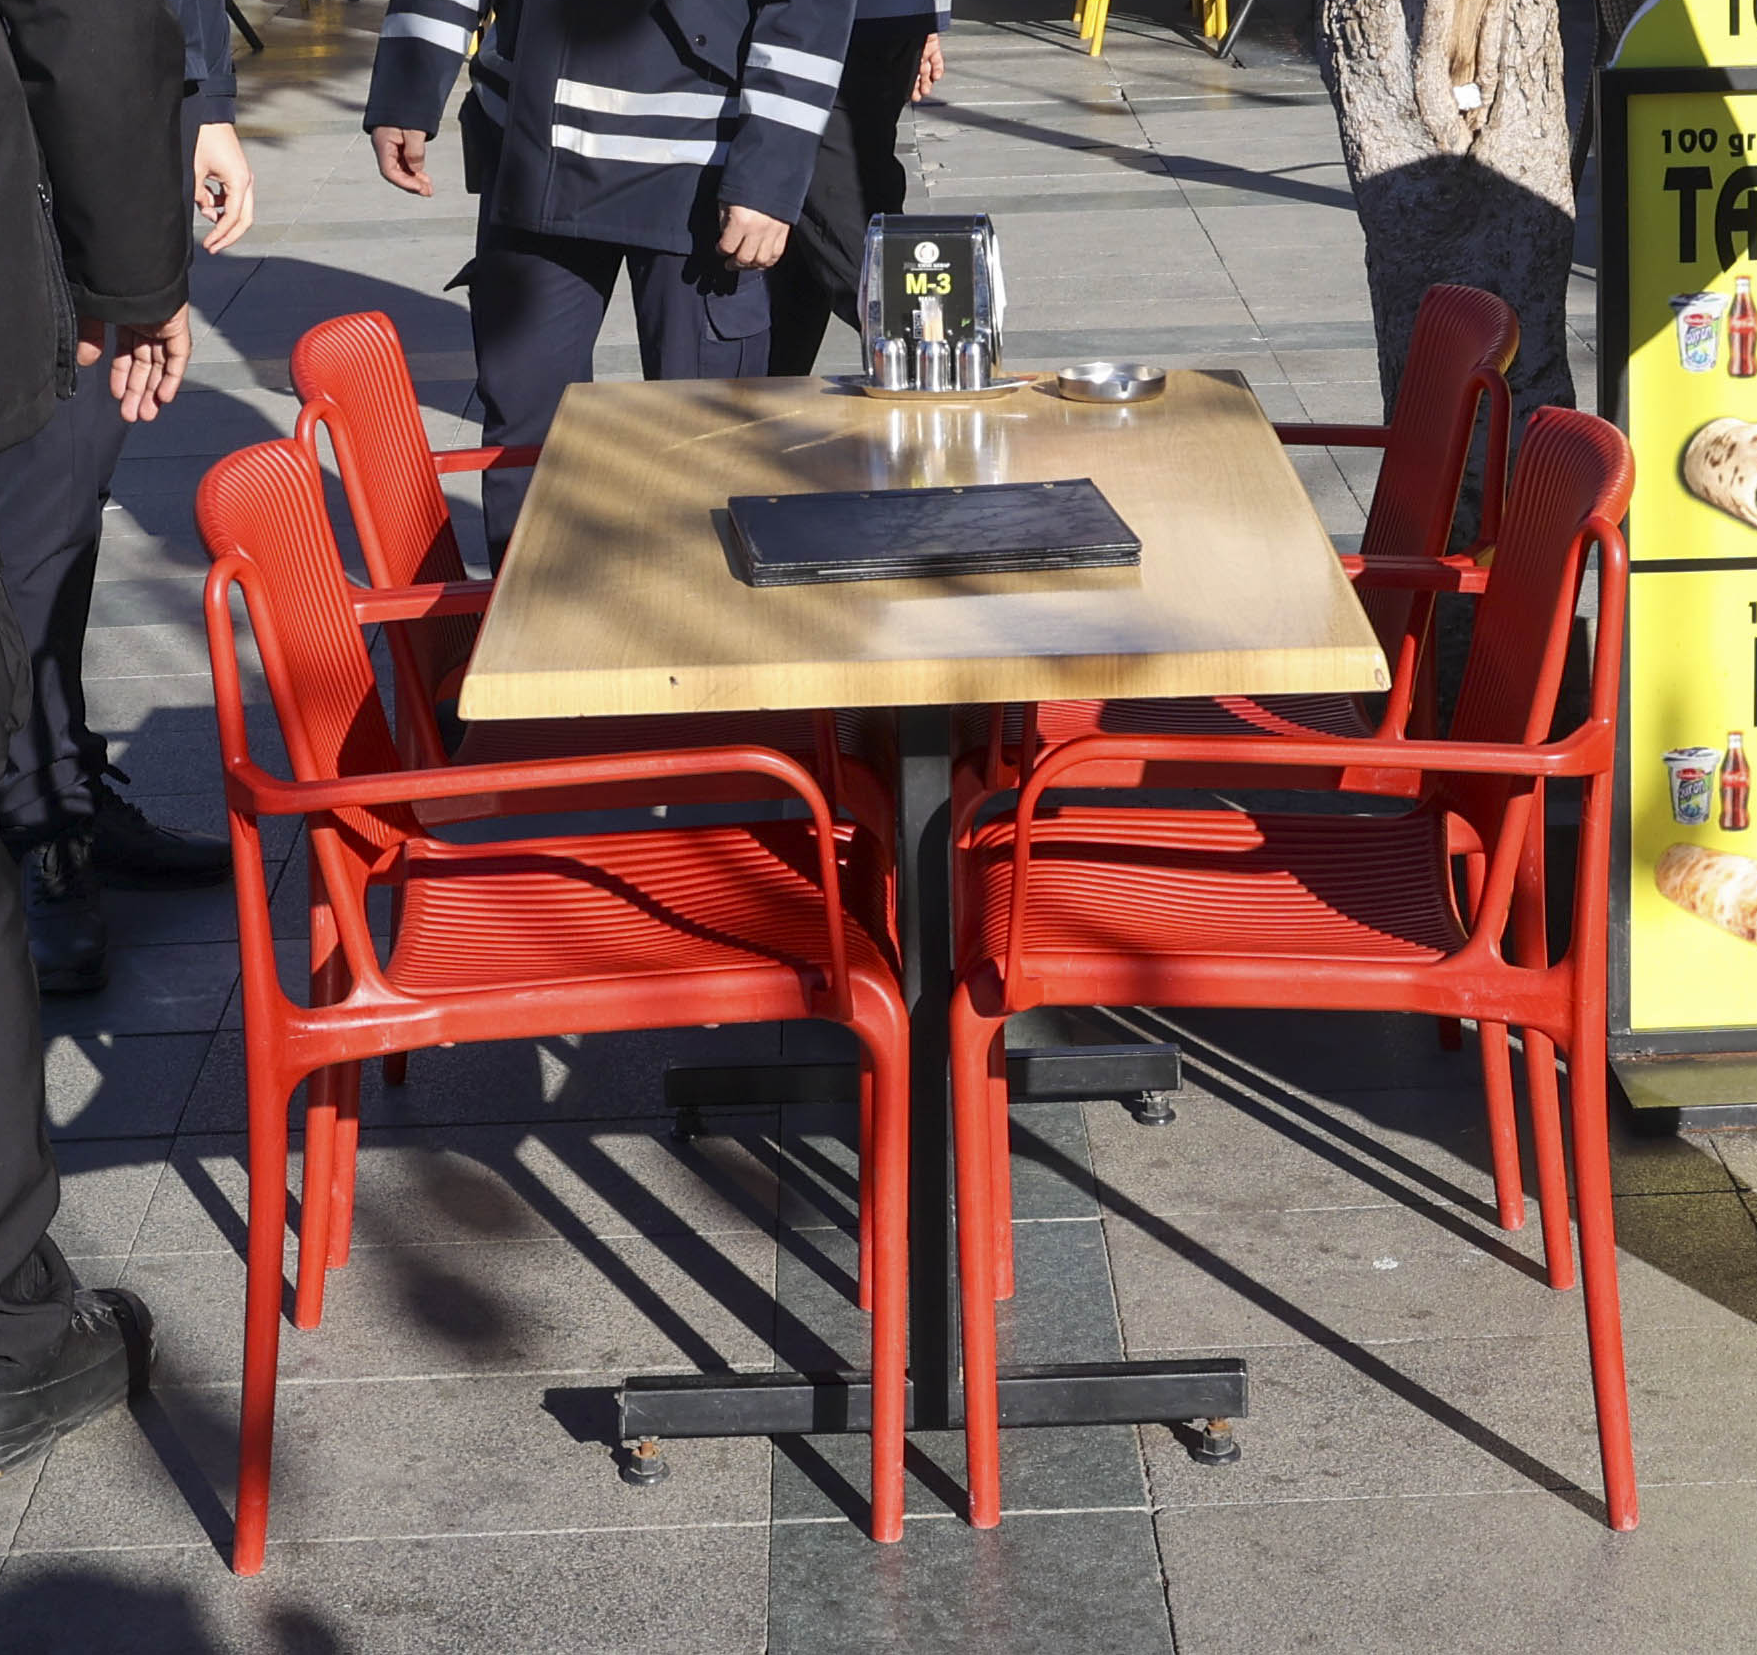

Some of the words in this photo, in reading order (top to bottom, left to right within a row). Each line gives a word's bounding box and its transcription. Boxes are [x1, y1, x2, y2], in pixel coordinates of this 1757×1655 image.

[1660, 128, 1718, 155] 100
[1729, 128, 1757, 158] gr
[905, 272, 952, 295] M-3
